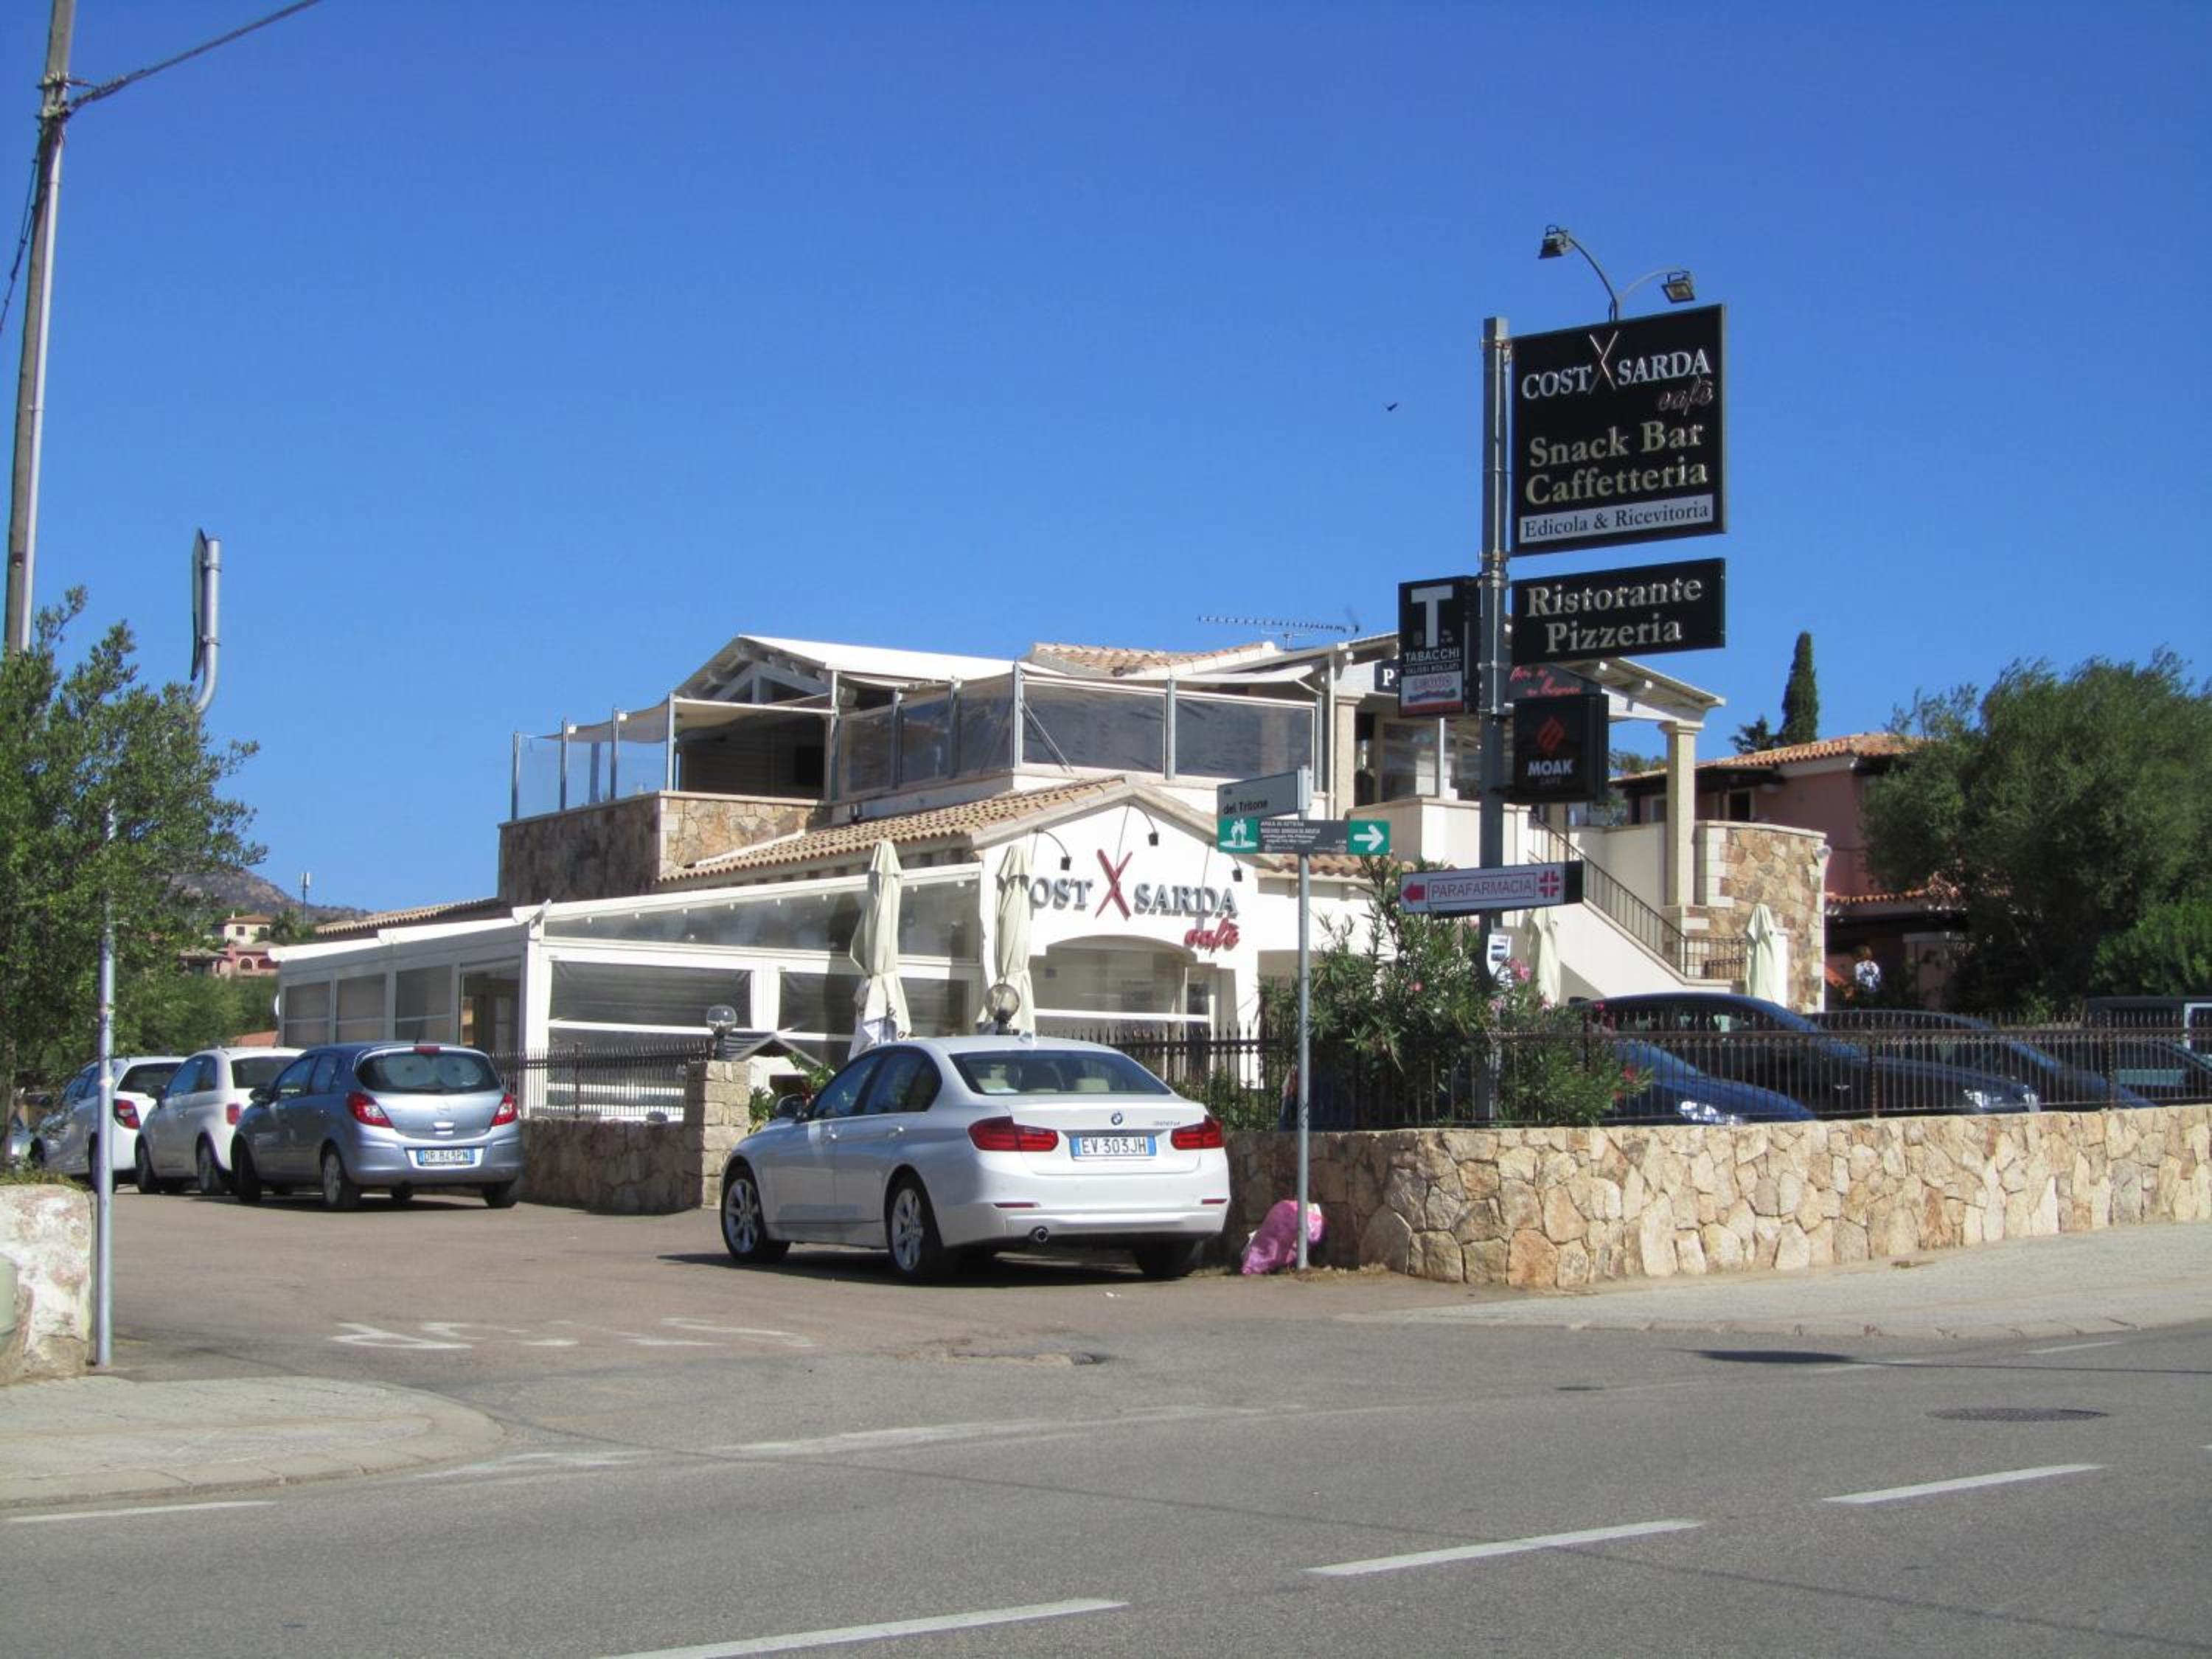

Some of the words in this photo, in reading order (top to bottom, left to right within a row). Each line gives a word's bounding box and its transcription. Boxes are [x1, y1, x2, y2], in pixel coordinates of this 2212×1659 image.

[1617, 348, 1711, 385] SARDA
[1529, 425, 1630, 467] Snack
[1640, 421, 1703, 452] Bar
[1526, 456, 1708, 505] Caffetteria
[1524, 518, 1587, 538] Edicola
[1593, 512, 1608, 529] &
[1615, 501, 1708, 527] Ricevitoria
[1526, 577, 1703, 616] Ristorante
[1545, 613, 1683, 653] Pizzeria
[1405, 647, 1459, 663] TABACCHI
[1527, 759, 1573, 776] MOAK
[1223, 803, 1237, 814] del
[1133, 884, 1239, 919] SARDA
[1431, 879, 1532, 897] PARAFARMACIA
[1082, 1138, 1098, 1154] EV
[1104, 1138, 1147, 1155] 303JH
